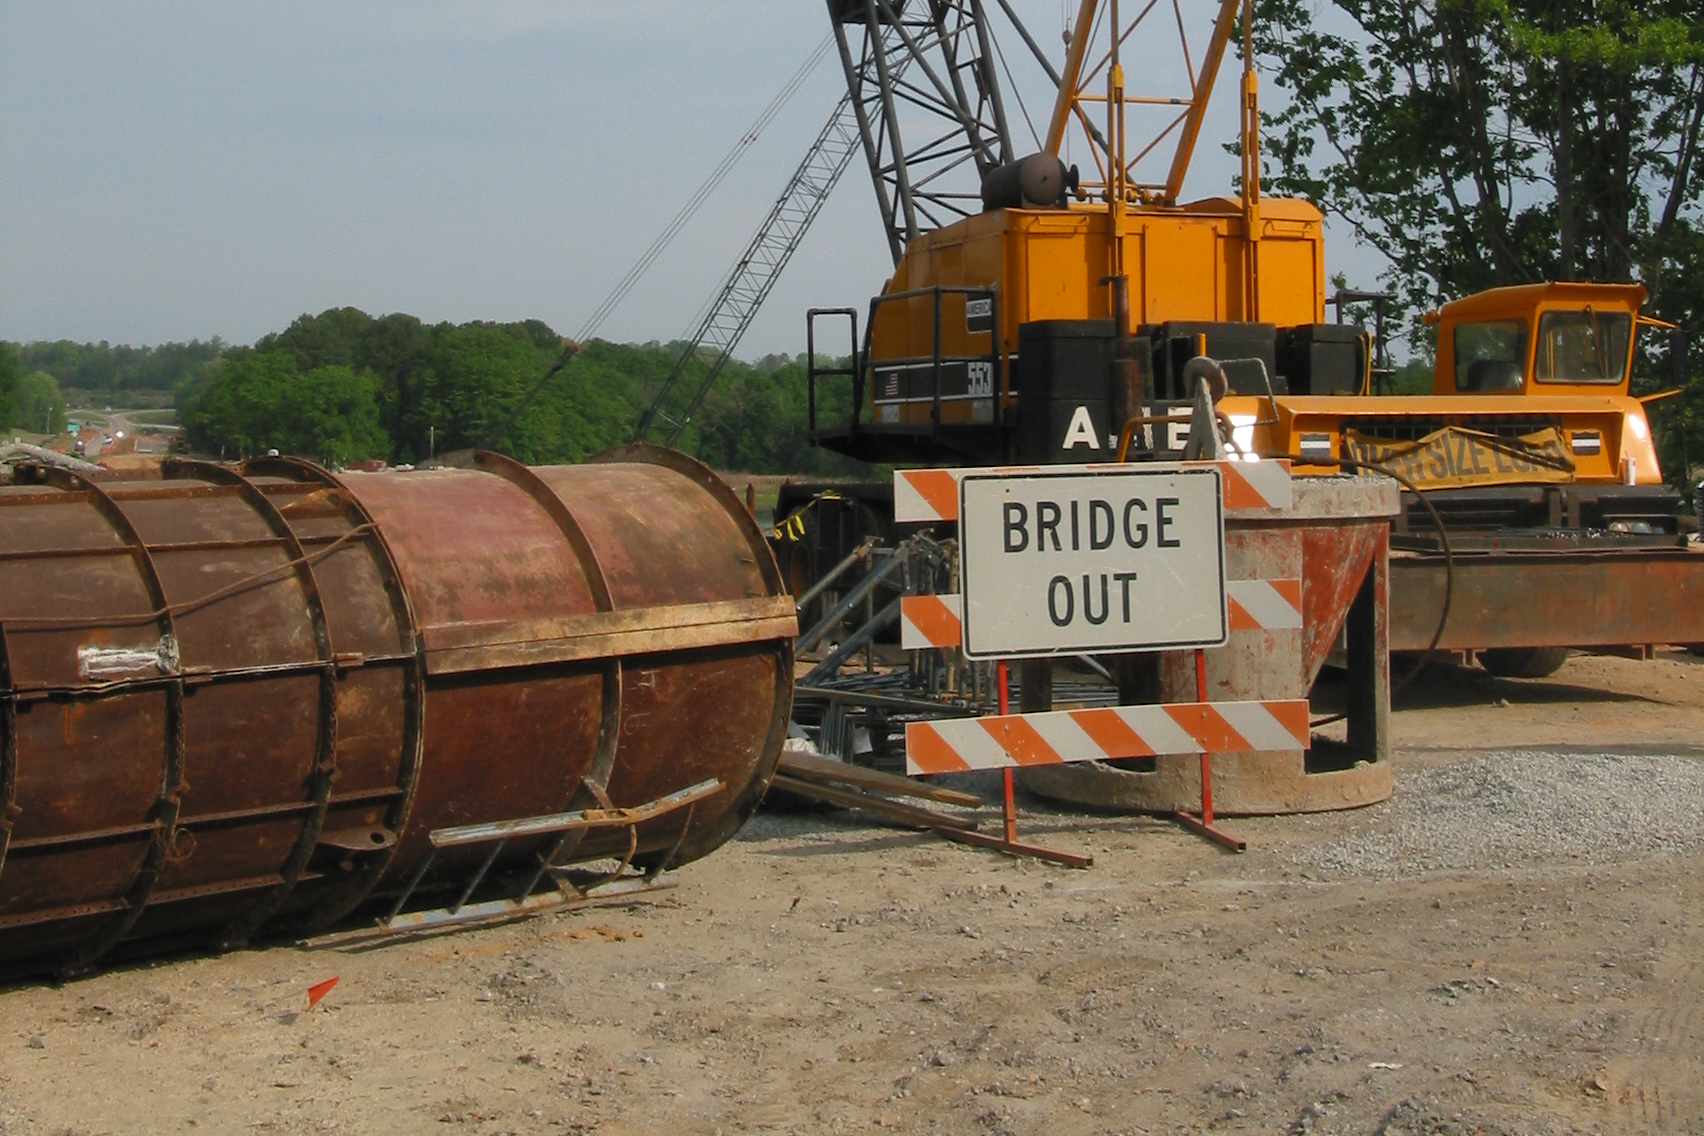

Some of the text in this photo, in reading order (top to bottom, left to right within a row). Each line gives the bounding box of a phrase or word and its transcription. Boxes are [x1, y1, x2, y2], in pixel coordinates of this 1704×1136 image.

[967, 362, 993, 395] 553
[1003, 498, 1181, 553] BRIDGE
[1047, 572, 1138, 627] OUT
